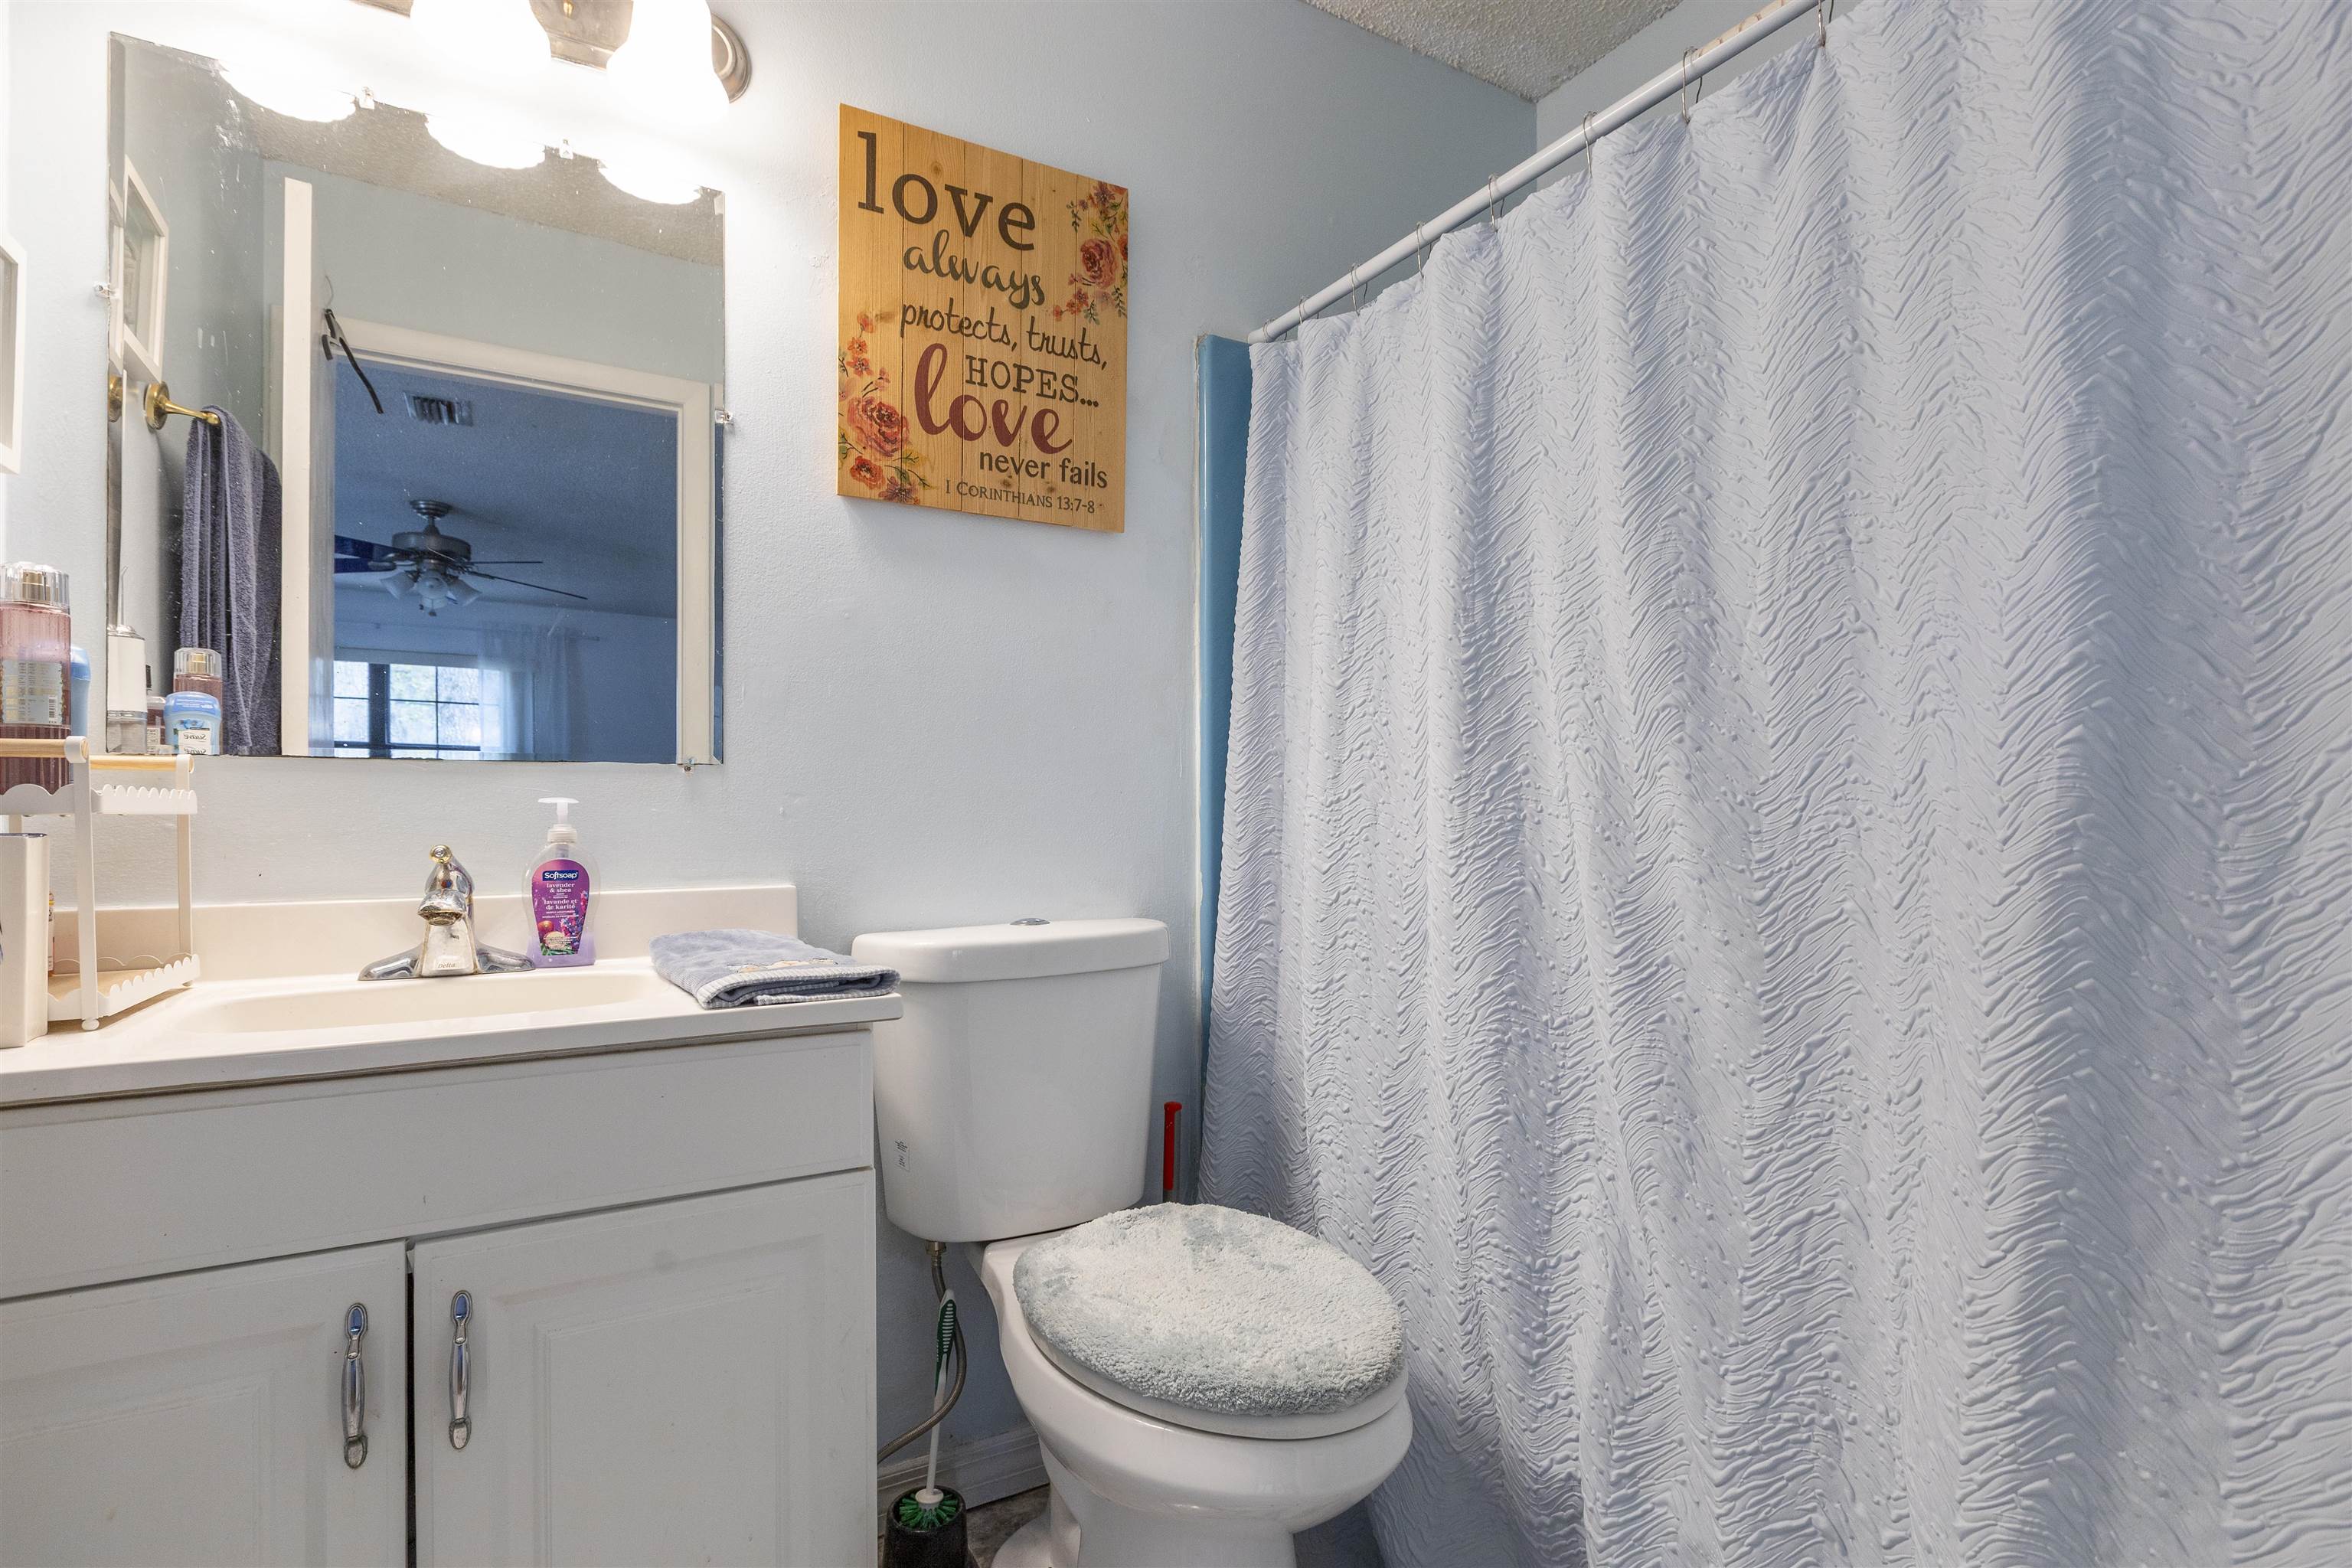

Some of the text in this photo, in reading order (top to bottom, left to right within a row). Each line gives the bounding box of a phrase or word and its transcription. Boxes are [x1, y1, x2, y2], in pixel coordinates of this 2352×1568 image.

[857, 131, 1036, 251] love
[903, 229, 1045, 309] always
[900, 297, 1107, 371] protects, trusts,
[914, 342, 1073, 455] love
[965, 354, 1099, 407] HOPES...
[979, 452, 1108, 488] never fails
[1057, 496, 1095, 514] 13:7-8
[544, 871, 577, 880] Softsoap
